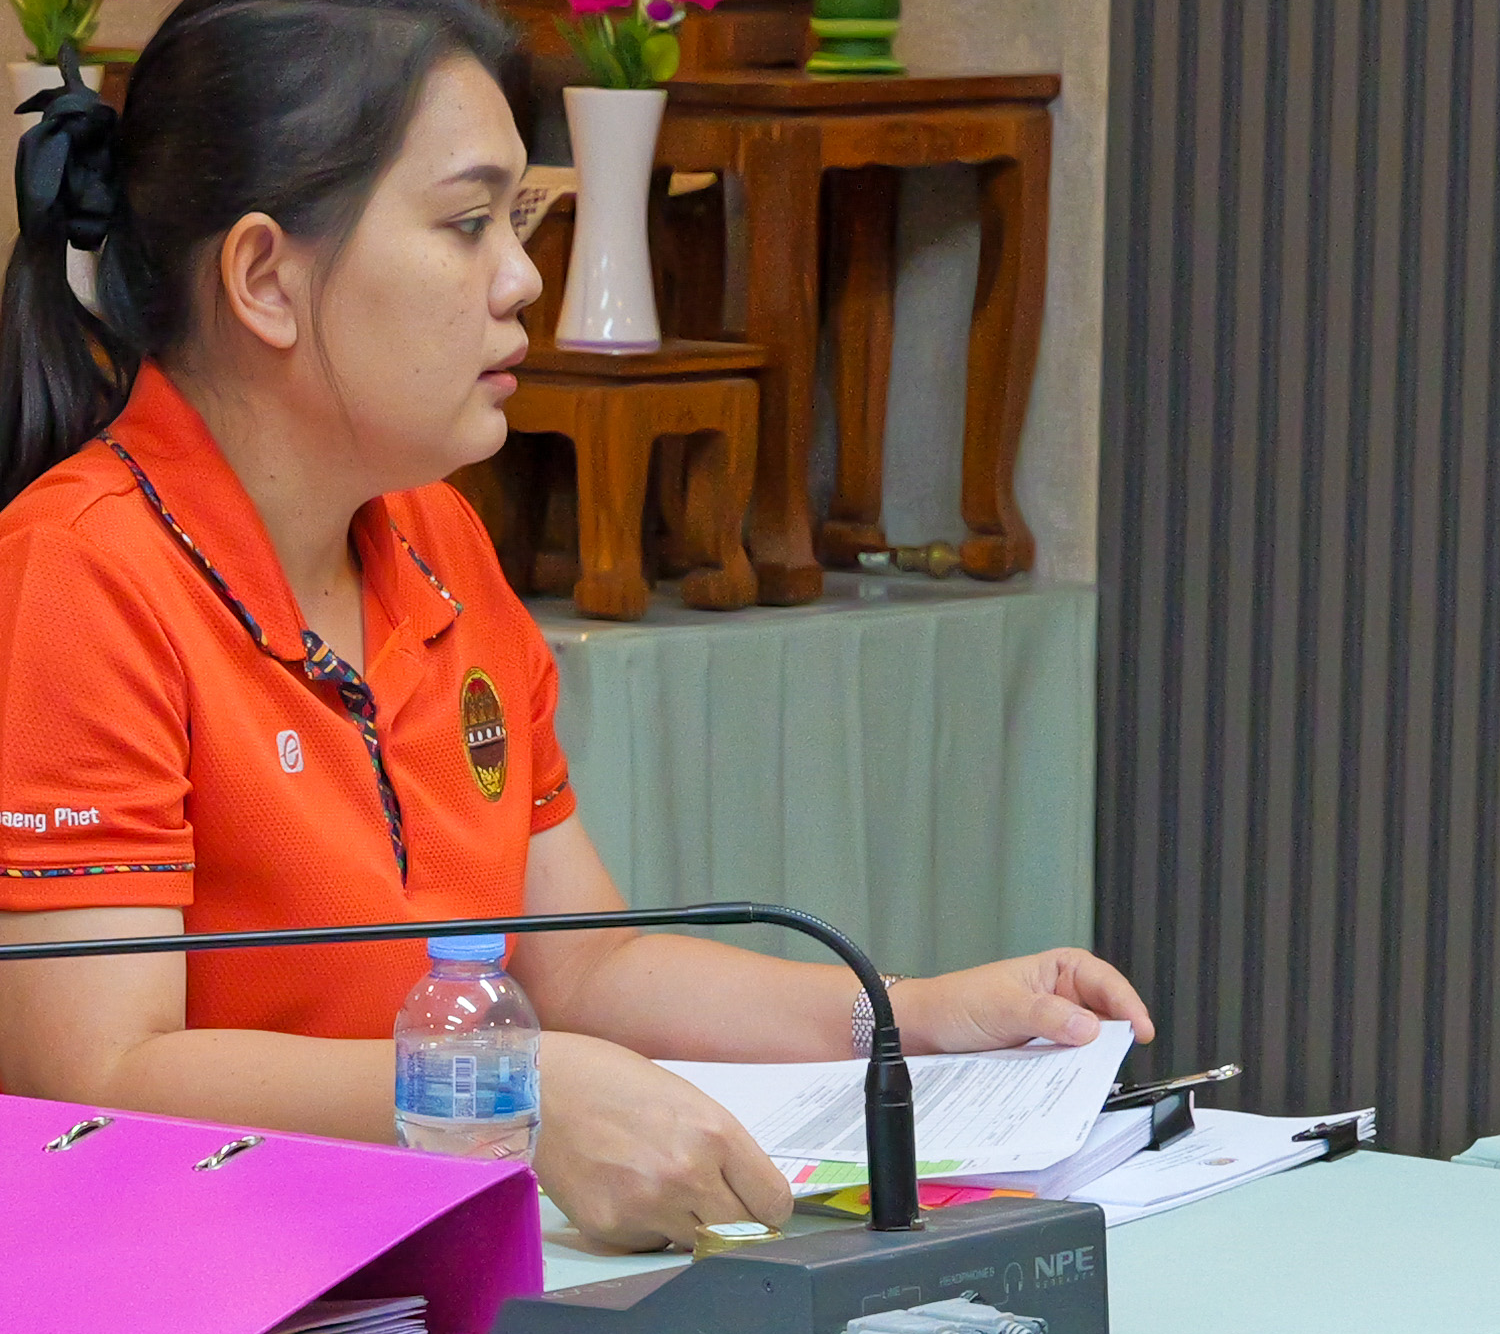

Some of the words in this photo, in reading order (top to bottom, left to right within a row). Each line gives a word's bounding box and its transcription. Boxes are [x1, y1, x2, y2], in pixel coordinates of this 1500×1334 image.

[54, 807, 100, 827] Phet
[1035, 1246, 1094, 1279] NPE
[939, 1267, 995, 1287] HEADPHONES
